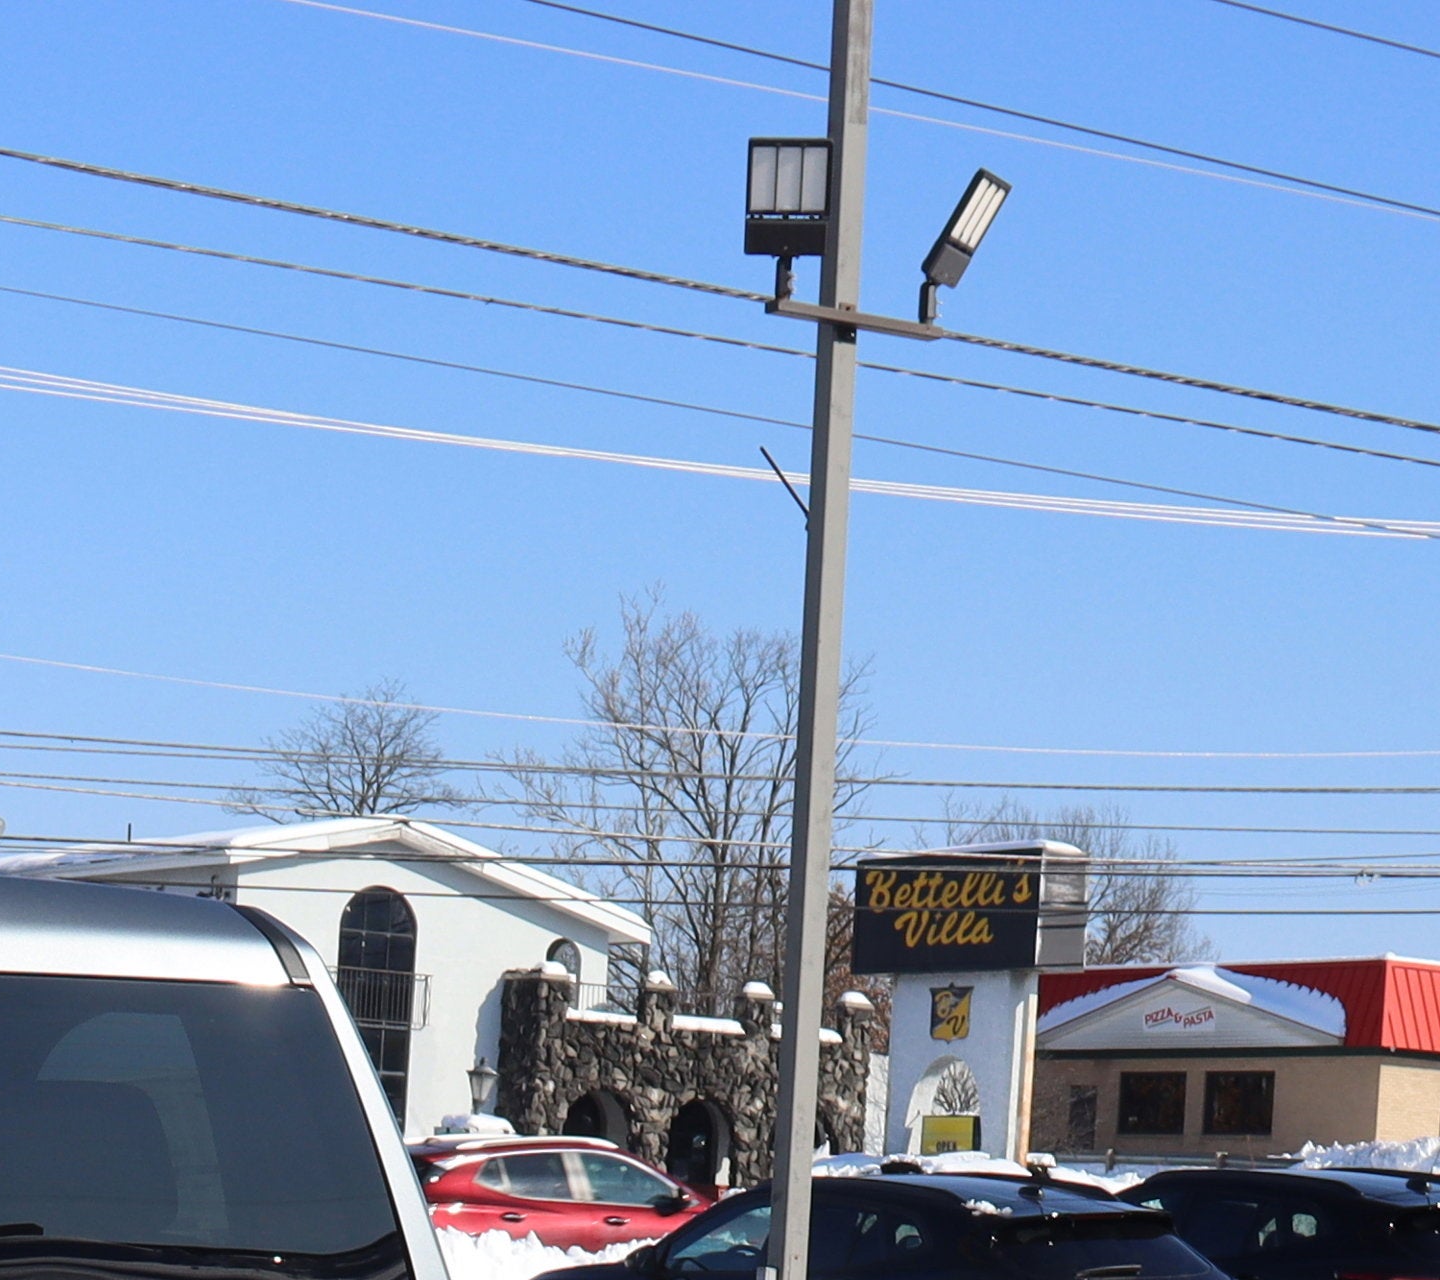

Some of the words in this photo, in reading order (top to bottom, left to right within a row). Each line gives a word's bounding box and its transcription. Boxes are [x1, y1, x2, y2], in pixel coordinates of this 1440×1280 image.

[865, 859, 1032, 913] Bettelli's
[894, 909, 994, 948] Villa
[1144, 1007, 1173, 1025] PIZZA
[1183, 1009, 1214, 1028] PASTA
